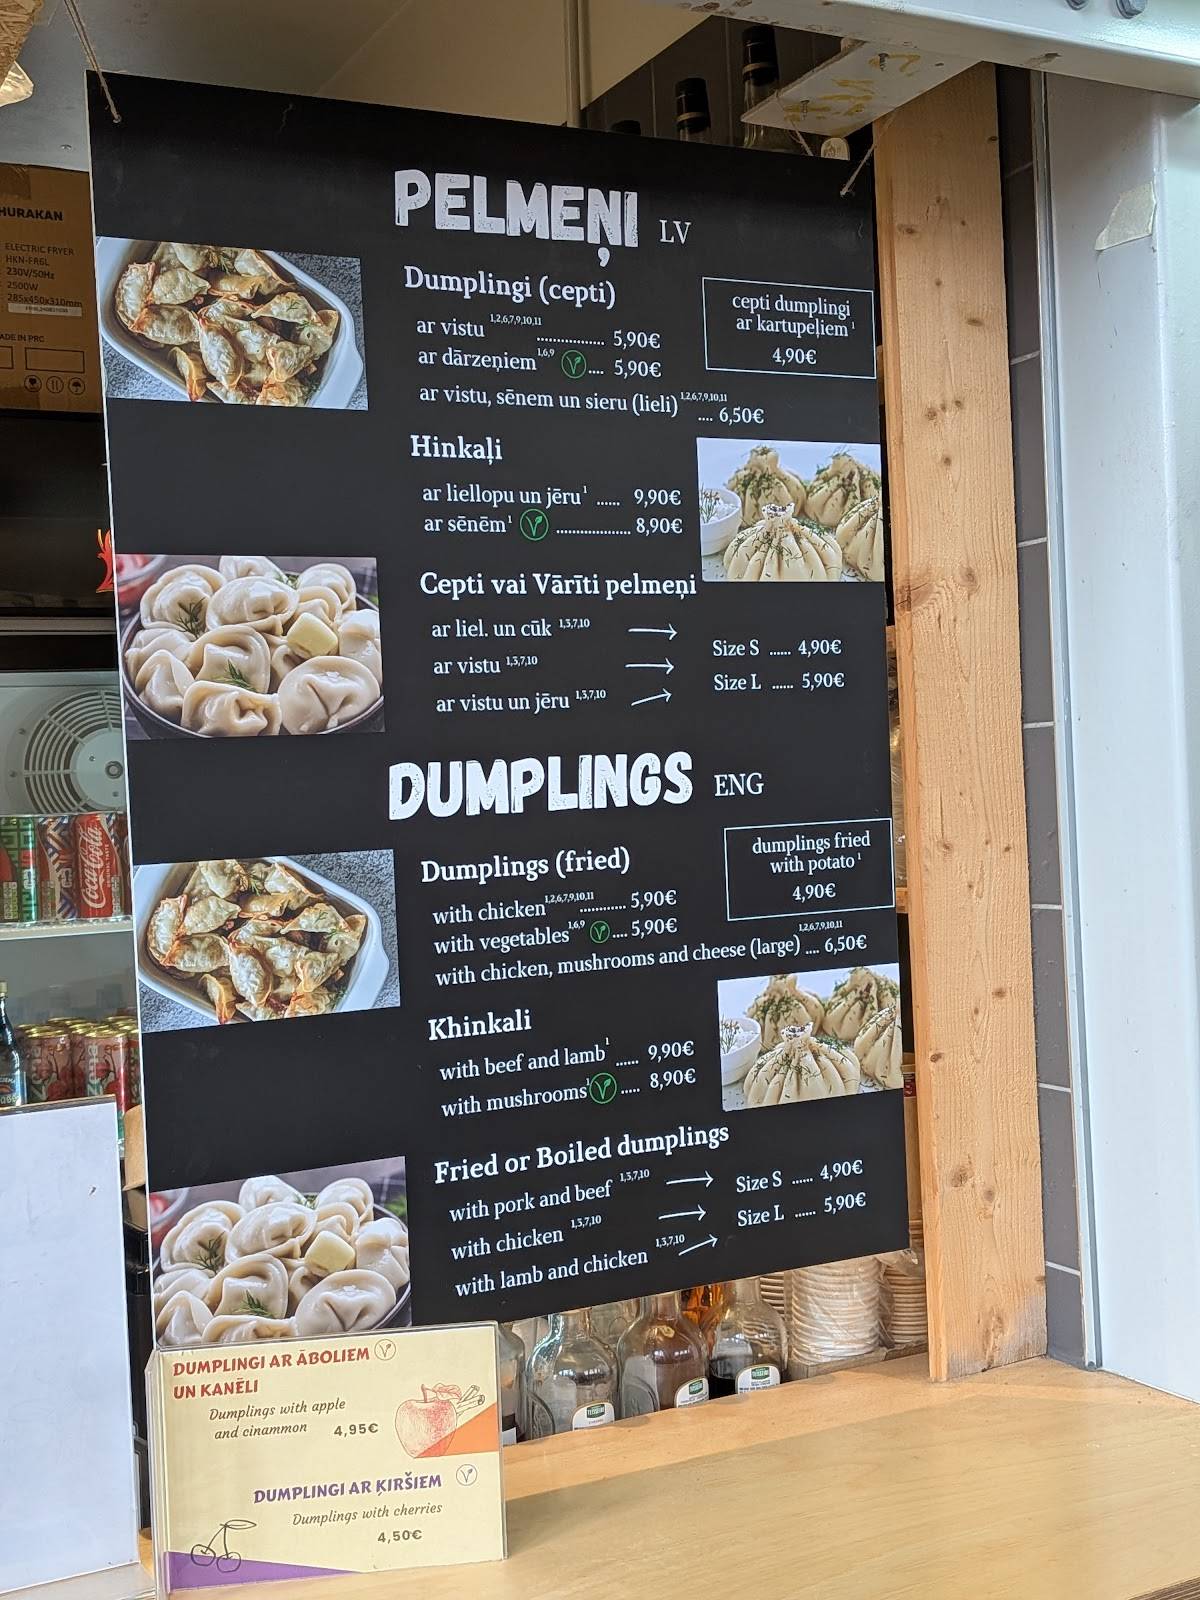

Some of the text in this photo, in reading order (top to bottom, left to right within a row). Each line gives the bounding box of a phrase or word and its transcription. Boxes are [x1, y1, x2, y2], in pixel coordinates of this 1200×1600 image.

[394, 169, 692, 268] PELMEŅI LV
[5, 242, 74, 256] ELECTRIC FRYER
[6, 266, 55, 280] 230V/50Hz
[7, 281, 39, 291] 2500W
[403, 265, 616, 310] Dumplingi (cepti)
[732, 294, 851, 321] cepti dumplingi
[0, 333, 16, 341] ADE
[416, 320, 436, 334] ar
[440, 317, 485, 338] vistu
[613, 329, 661, 350] 5,90€
[736, 317, 753, 331] ar
[756, 313, 849, 339] kartupeļiem
[418, 350, 438, 365] ar
[441, 346, 537, 373] dārzeņiem
[614, 358, 662, 379] 5,90€
[772, 347, 817, 367] 4,90€
[419, 387, 439, 402] ar
[442, 384, 492, 408] vistu,
[496, 388, 554, 408] sēnem
[558, 395, 581, 409] un
[585, 392, 628, 411] sieru
[632, 392, 678, 418] (lieli)
[719, 406, 765, 426] 6,50€
[410, 434, 503, 466] Hinkaļi
[422, 488, 442, 502] ar
[446, 482, 515, 508] liellopu
[519, 490, 542, 504] un
[545, 487, 582, 510] jēru
[633, 488, 682, 509] 9,90€
[424, 518, 444, 532] ar
[447, 515, 507, 533] sēnēm
[636, 517, 683, 537] 8,90€
[420, 571, 697, 601] Cepti vai Vārīti pelmeņi
[431, 624, 451, 638] ar
[455, 618, 489, 638] liel.
[492, 624, 517, 637] un
[520, 618, 553, 637] cūk
[712, 638, 842, 658] Size S 4,90€
[433, 661, 453, 675] ar
[456, 656, 501, 674] vistu
[713, 671, 845, 692] Size L 5,90€
[436, 698, 456, 712] ar
[459, 693, 504, 712] vistu
[507, 697, 531, 711] un
[534, 692, 570, 715] jēru
[388, 751, 765, 821] DUMPLINGS ENG
[752, 829, 871, 857] dumplings fried
[420, 845, 630, 885] Dumplings (fried)
[769, 854, 805, 874] with
[807, 855, 855, 876] potato
[432, 903, 474, 925] with
[477, 899, 547, 921] chicken
[630, 889, 677, 911] 5,90€
[792, 882, 836, 904] 4,90€
[433, 933, 475, 954] with
[478, 926, 570, 954] vegetables
[631, 917, 678, 940] 5,90€
[434, 965, 477, 986] with
[480, 960, 553, 982] chicken,
[557, 952, 655, 974] mushrooms
[658, 944, 689, 965] and
[692, 942, 746, 961] cheese
[750, 934, 801, 960] (large)
[824, 934, 868, 955] 6,50€
[427, 1008, 532, 1041] Khinkali
[439, 1059, 481, 1081] with
[483, 1052, 525, 1076] beef
[527, 1048, 560, 1070] and
[563, 1044, 606, 1066] lamb
[647, 1040, 695, 1063] 9,90€
[440, 1095, 482, 1117] with
[486, 1086, 588, 1112] mushrooms
[649, 1067, 696, 1091] 8,90€
[434, 1125, 730, 1185] Fried or Boiled dumplings
[736, 1159, 863, 1193] Size S 4,90€
[448, 1199, 490, 1222] with
[494, 1196, 535, 1220] pork
[539, 1185, 572, 1208] and
[574, 1178, 613, 1202] beef
[737, 1191, 866, 1227] Size L 5,90€
[450, 1237, 492, 1260] with
[496, 1228, 564, 1252] chicken
[454, 1273, 496, 1297] with
[500, 1265, 544, 1289] lamb
[547, 1257, 580, 1281] and
[583, 1249, 649, 1274] chicken
[173, 1346, 370, 1377] DUMPLINGI AR ĀBOLIEM
[173, 1377, 259, 1400] UN KANĒLI
[209, 1396, 346, 1423] Dumplings with apple
[214, 1422, 379, 1440] and cinammon 4,95€
[253, 1471, 442, 1505] DUMPLINGI AR ĶIRŠIEM
[292, 1501, 443, 1527] Dumplings with cherries
[377, 1529, 423, 1545] 4,50€
